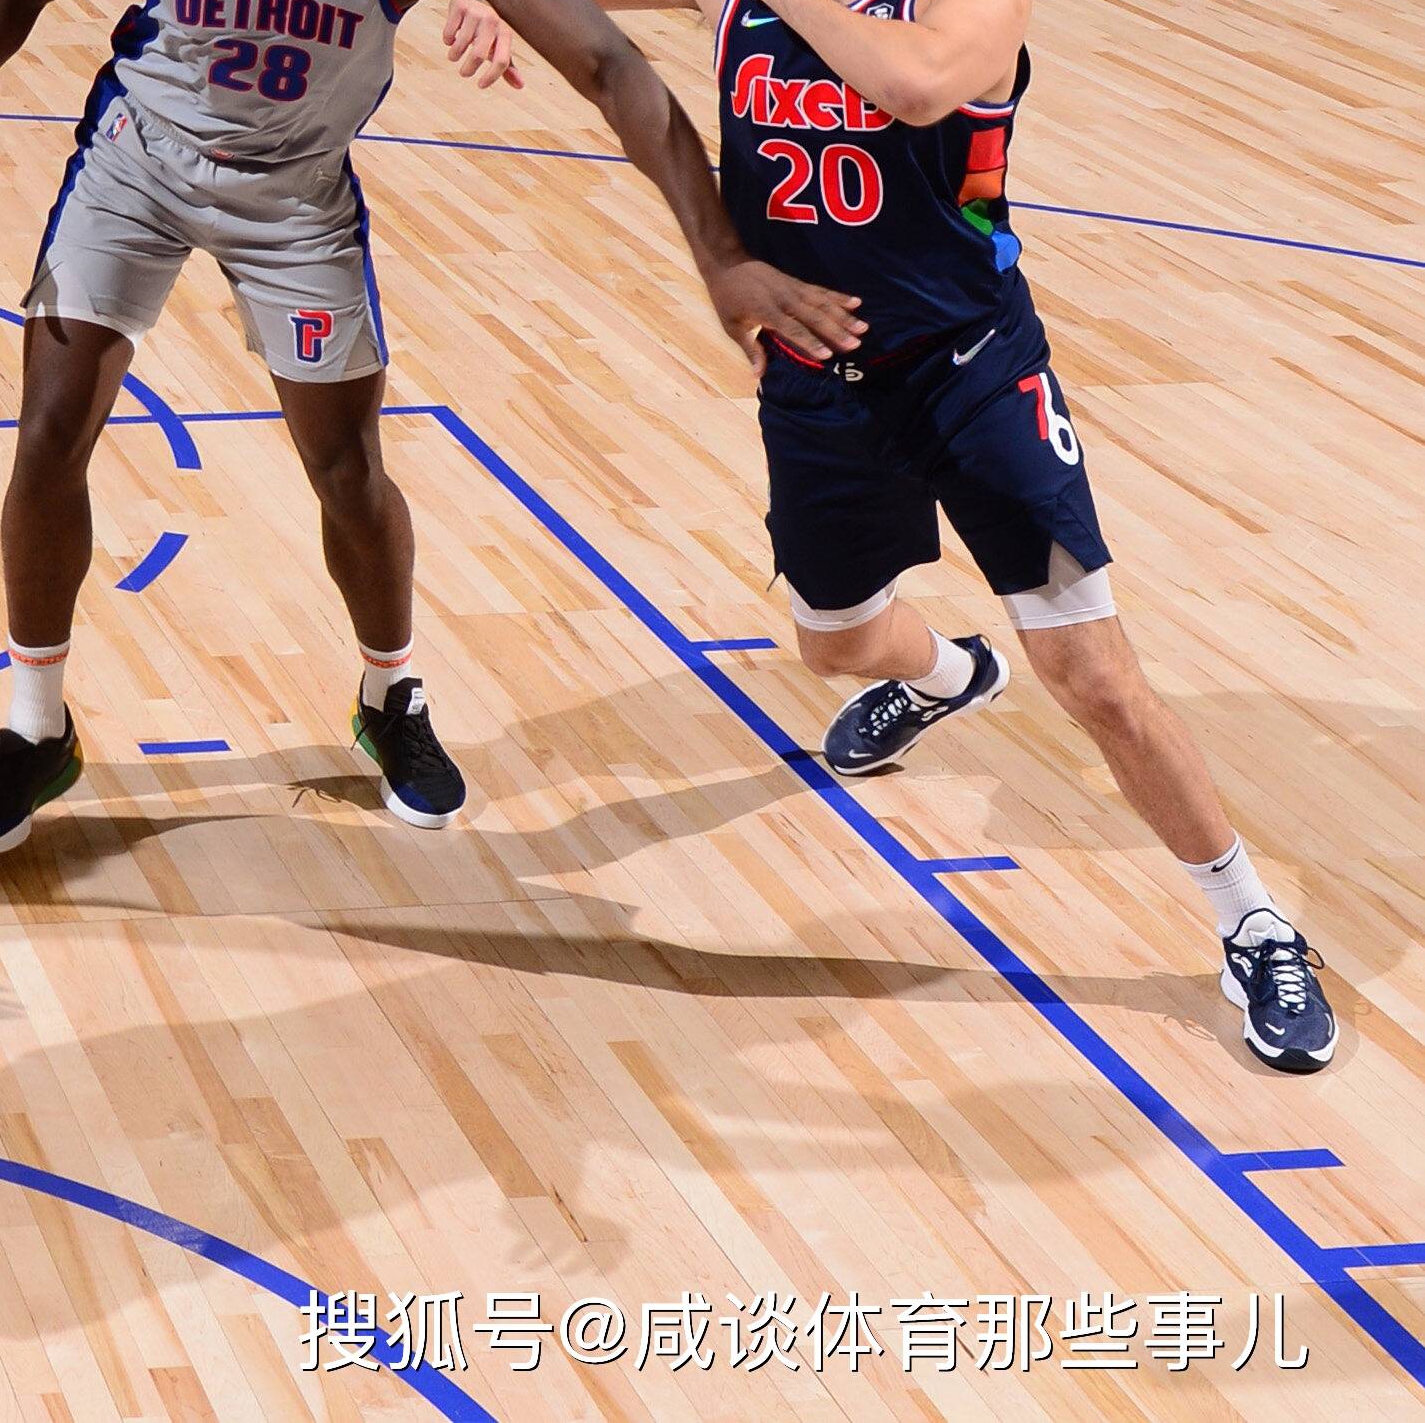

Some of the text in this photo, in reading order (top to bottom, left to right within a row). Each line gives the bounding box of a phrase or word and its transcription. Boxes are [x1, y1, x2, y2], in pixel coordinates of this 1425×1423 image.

[208, 38, 311, 102] 28
[757, 138, 884, 226] 20
[1017, 372, 1079, 466] 76
